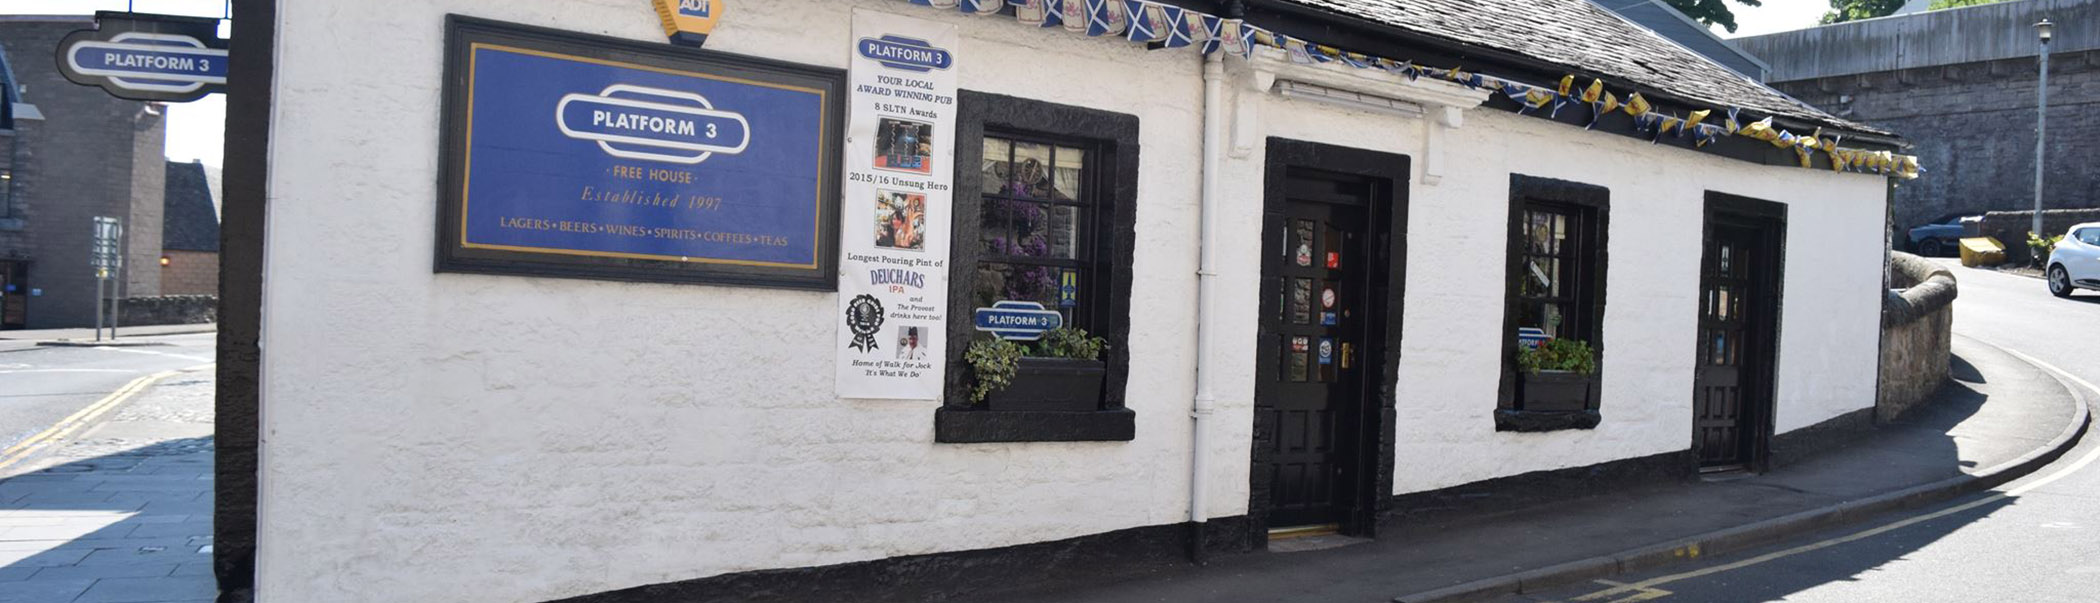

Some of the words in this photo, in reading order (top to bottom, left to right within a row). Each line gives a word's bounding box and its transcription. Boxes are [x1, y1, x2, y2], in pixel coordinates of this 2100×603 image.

[104, 53, 194, 71] PLATFORM
[199, 59, 210, 72] 3
[868, 43, 932, 63] PLATFORM
[936, 52, 943, 64] 3
[877, 75, 903, 86] YOUR
[905, 79, 934, 90] LOCAL
[857, 84, 891, 96] AWARD
[894, 89, 933, 102] WINNING
[934, 95, 953, 105] PUB
[874, 102, 881, 110] 8
[883, 104, 907, 114] SLTN
[909, 107, 937, 119] Awards
[593, 110, 695, 136] PLATFORM
[705, 123, 717, 138] 3
[613, 165, 643, 179] FREE
[649, 168, 692, 184] HOUSE
[849, 172, 889, 184] 2015/16
[892, 177, 924, 190] Unsung
[927, 181, 948, 191] Hero
[581, 186, 680, 208] Established
[688, 195, 722, 211] 1997
[500, 216, 550, 230] LAGERS
[559, 221, 597, 233] BEERS
[606, 223, 646, 237] WINES
[654, 226, 696, 240] SPIRITS
[703, 230, 752, 244] COFFEES
[760, 234, 788, 247] TEAS
[847, 252, 879, 263] Longest
[881, 255, 914, 267] Pouring
[915, 258, 932, 267] Pint
[870, 268, 925, 289] DEUCHARS
[889, 285, 905, 294] IPA
[910, 304, 935, 312] Provost
[912, 312, 928, 320] here
[988, 315, 1037, 326] PLATFORM
[1041, 317, 1048, 326] 3
[852, 359, 874, 367] Home
[875, 360, 882, 369] of
[884, 360, 901, 368] Walk
[902, 361, 914, 370] for
[879, 369, 896, 377] What
